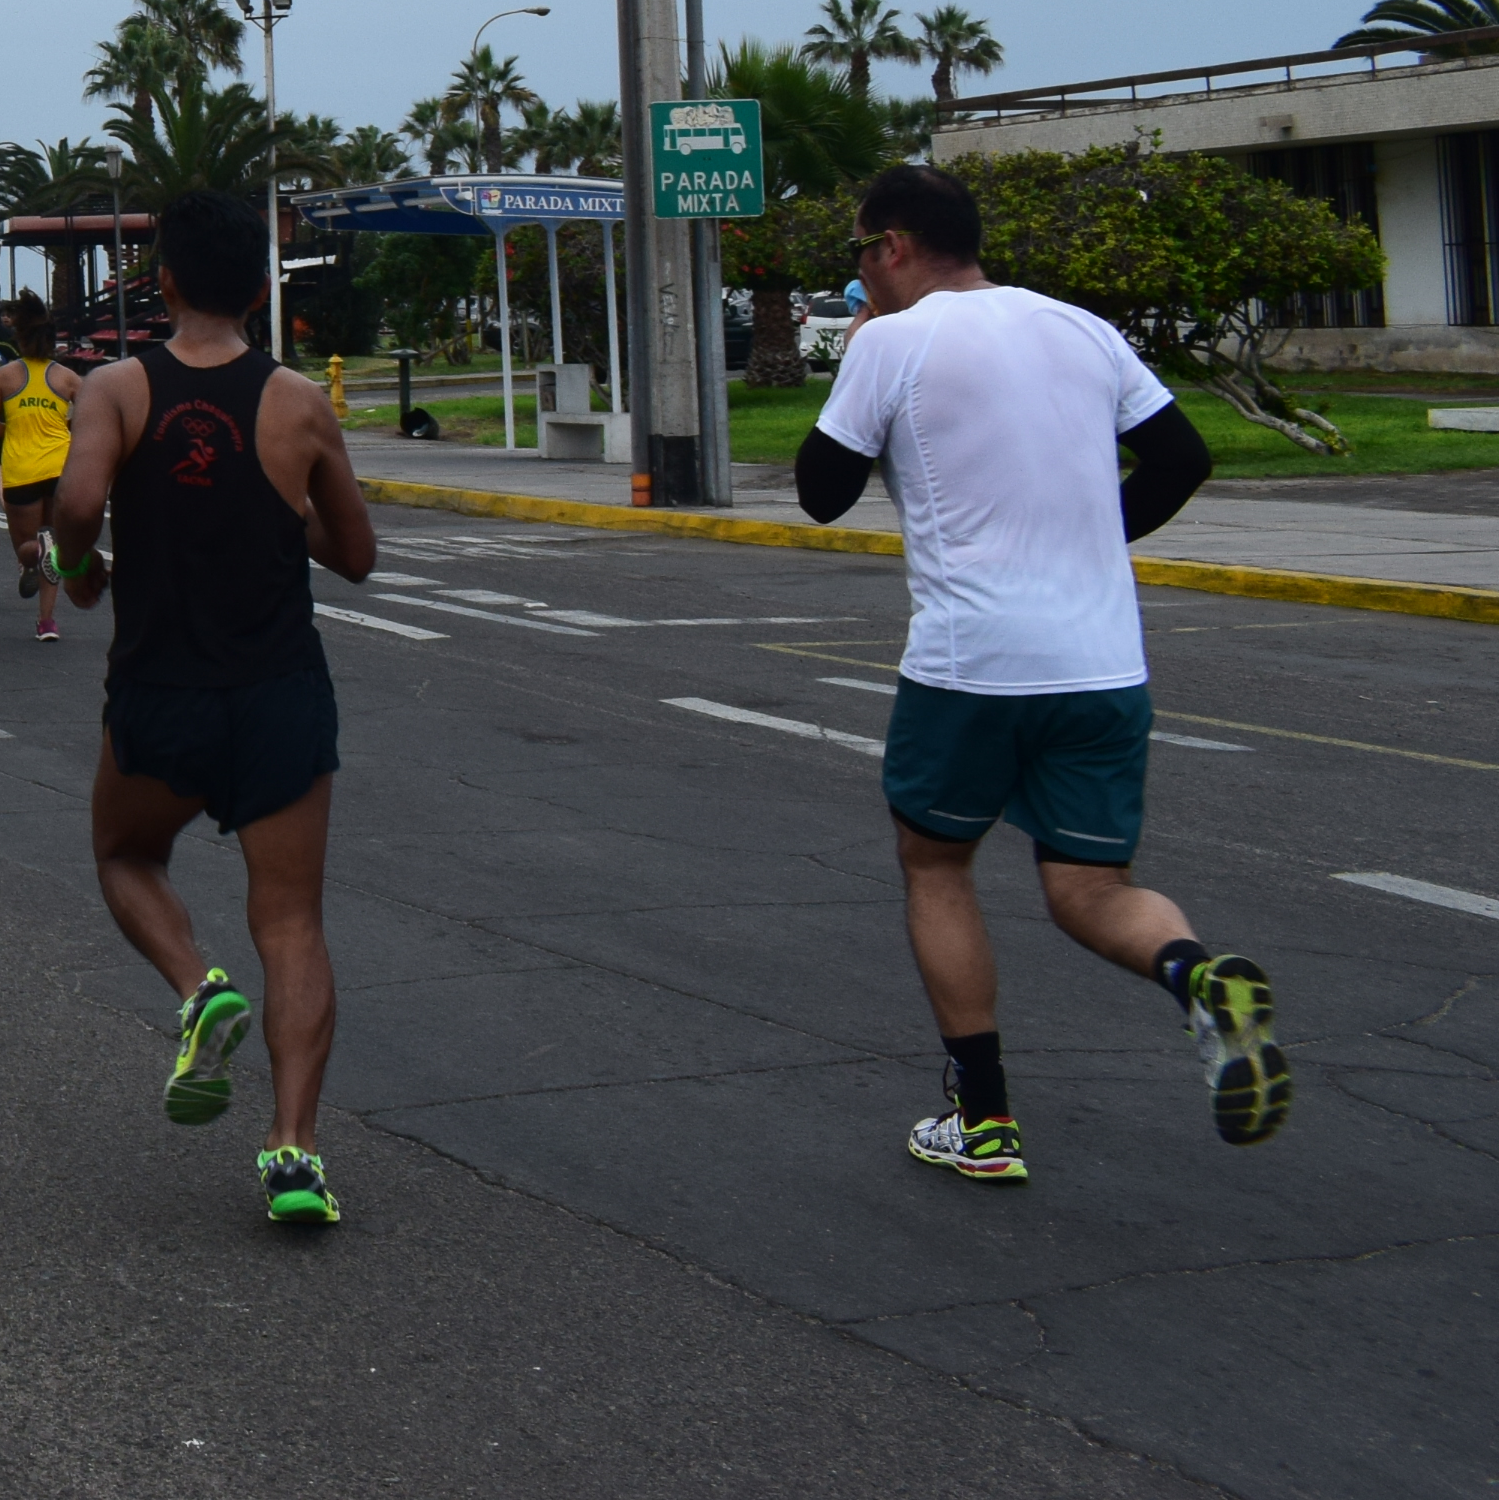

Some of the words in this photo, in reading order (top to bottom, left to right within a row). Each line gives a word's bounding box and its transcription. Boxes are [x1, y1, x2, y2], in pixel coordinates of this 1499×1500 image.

[661, 170, 755, 191] PARADA
[505, 195, 574, 211] PARADA
[579, 197, 624, 212] MIXT
[678, 193, 740, 213] MIXTA
[18, 397, 58, 411] ARICA
